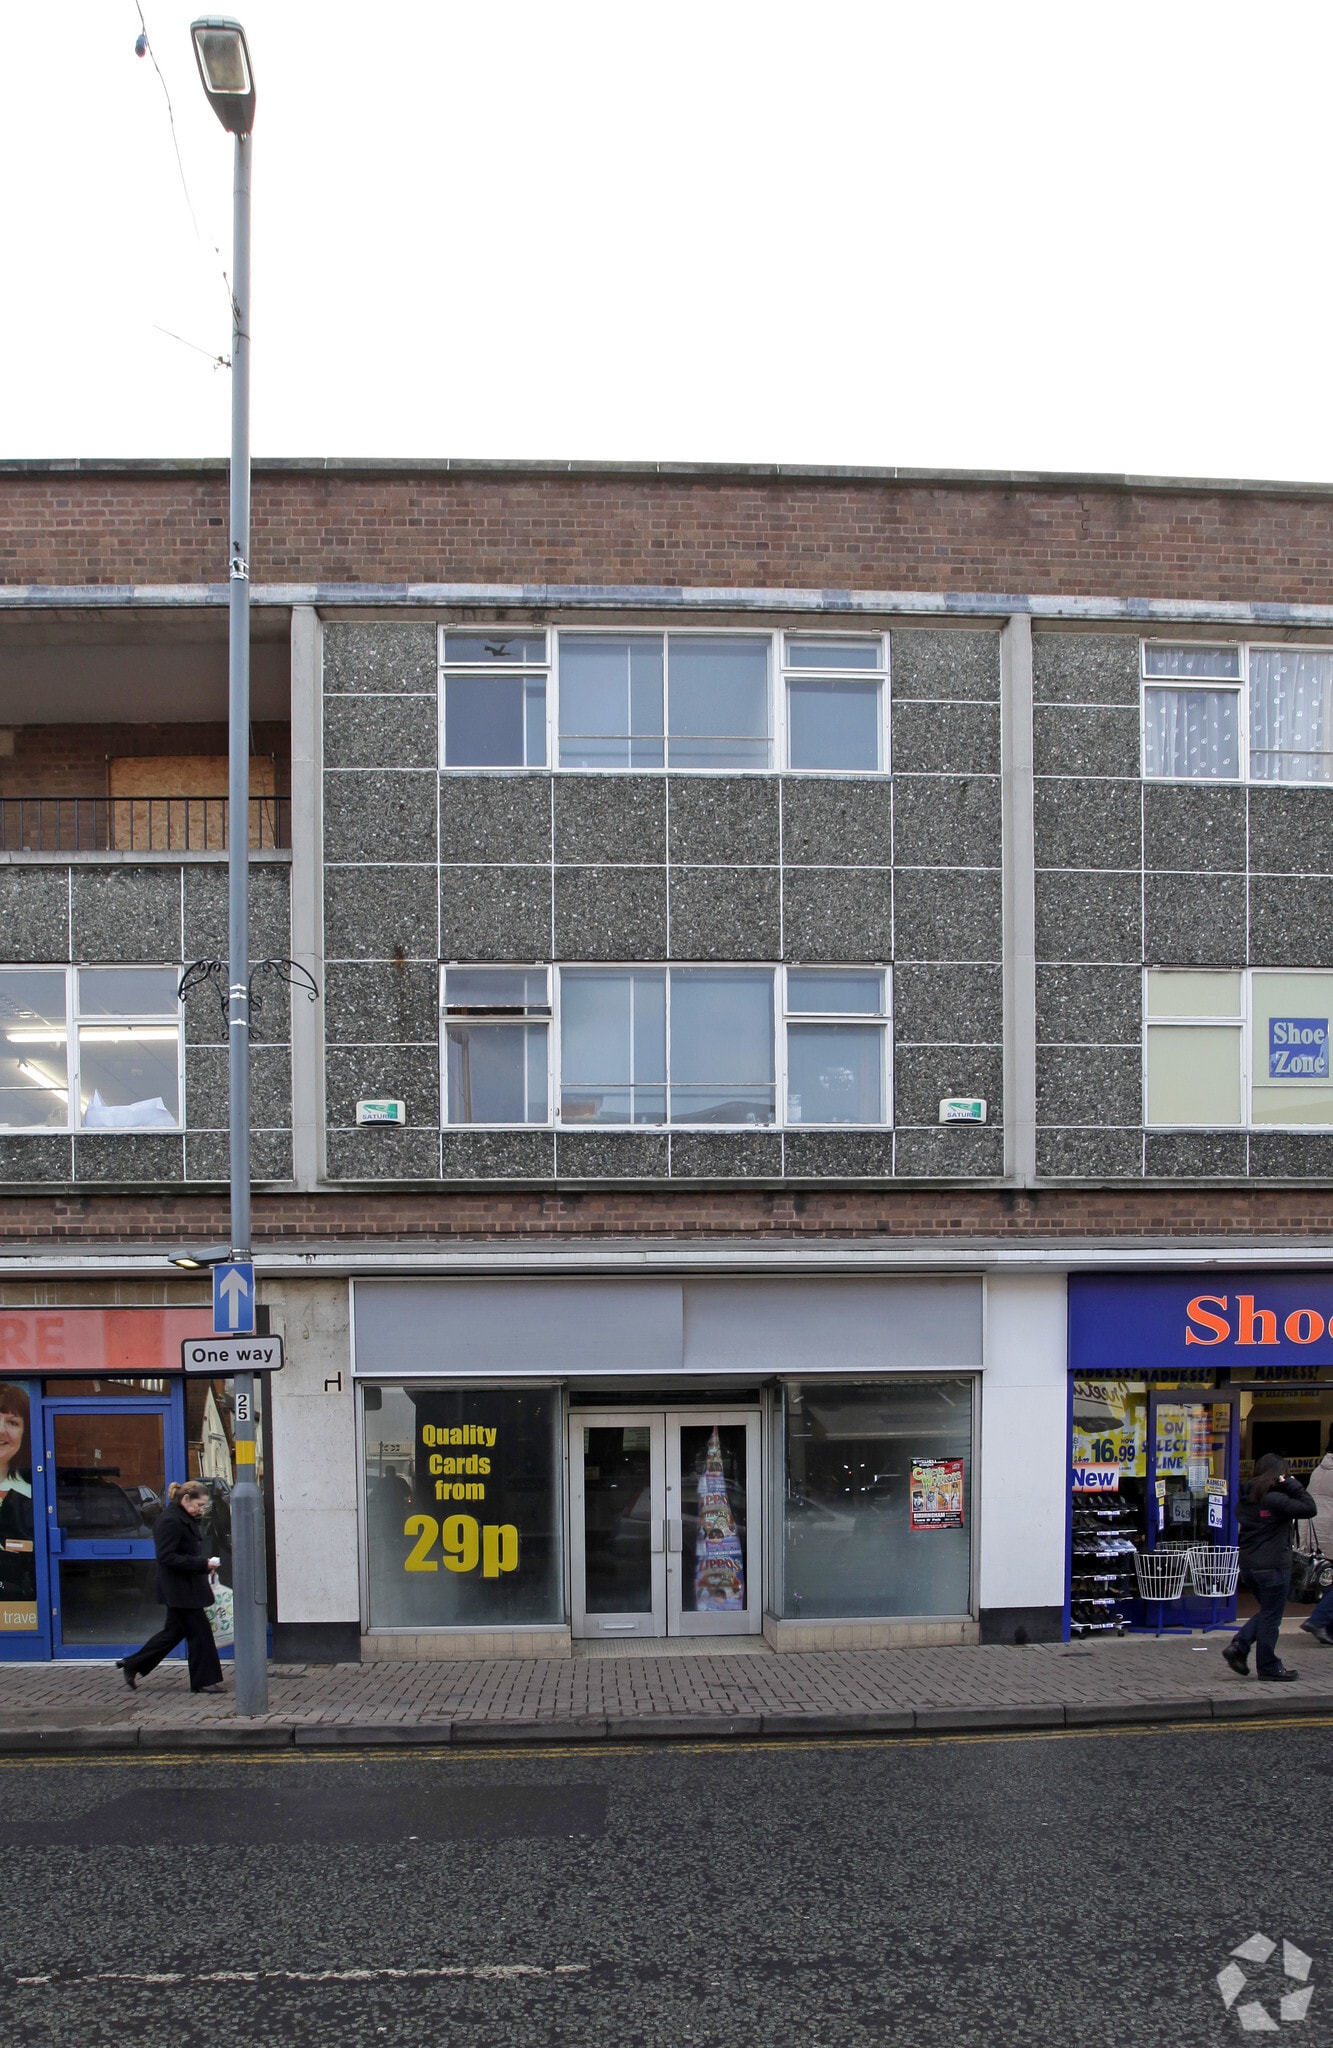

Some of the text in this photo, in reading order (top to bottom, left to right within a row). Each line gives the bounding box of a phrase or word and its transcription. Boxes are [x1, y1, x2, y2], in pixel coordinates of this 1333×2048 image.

[1274, 1022, 1325, 1045] Shoe
[1275, 1051, 1325, 1074] Zone
[1185, 1295, 1333, 1346] Sho
[192, 1348, 273, 1363] One way
[422, 1424, 497, 1447] Quality
[1164, 1421, 1184, 1435] ON
[1091, 1438, 1135, 1463] 16.99
[429, 1454, 491, 1475] Cards
[1072, 1468, 1115, 1487] New
[435, 1480, 485, 1500] from
[404, 1514, 519, 1578] 29p
[698, 1557, 743, 1573] ZIPPOS
[3, 1610, 37, 1624] trave
